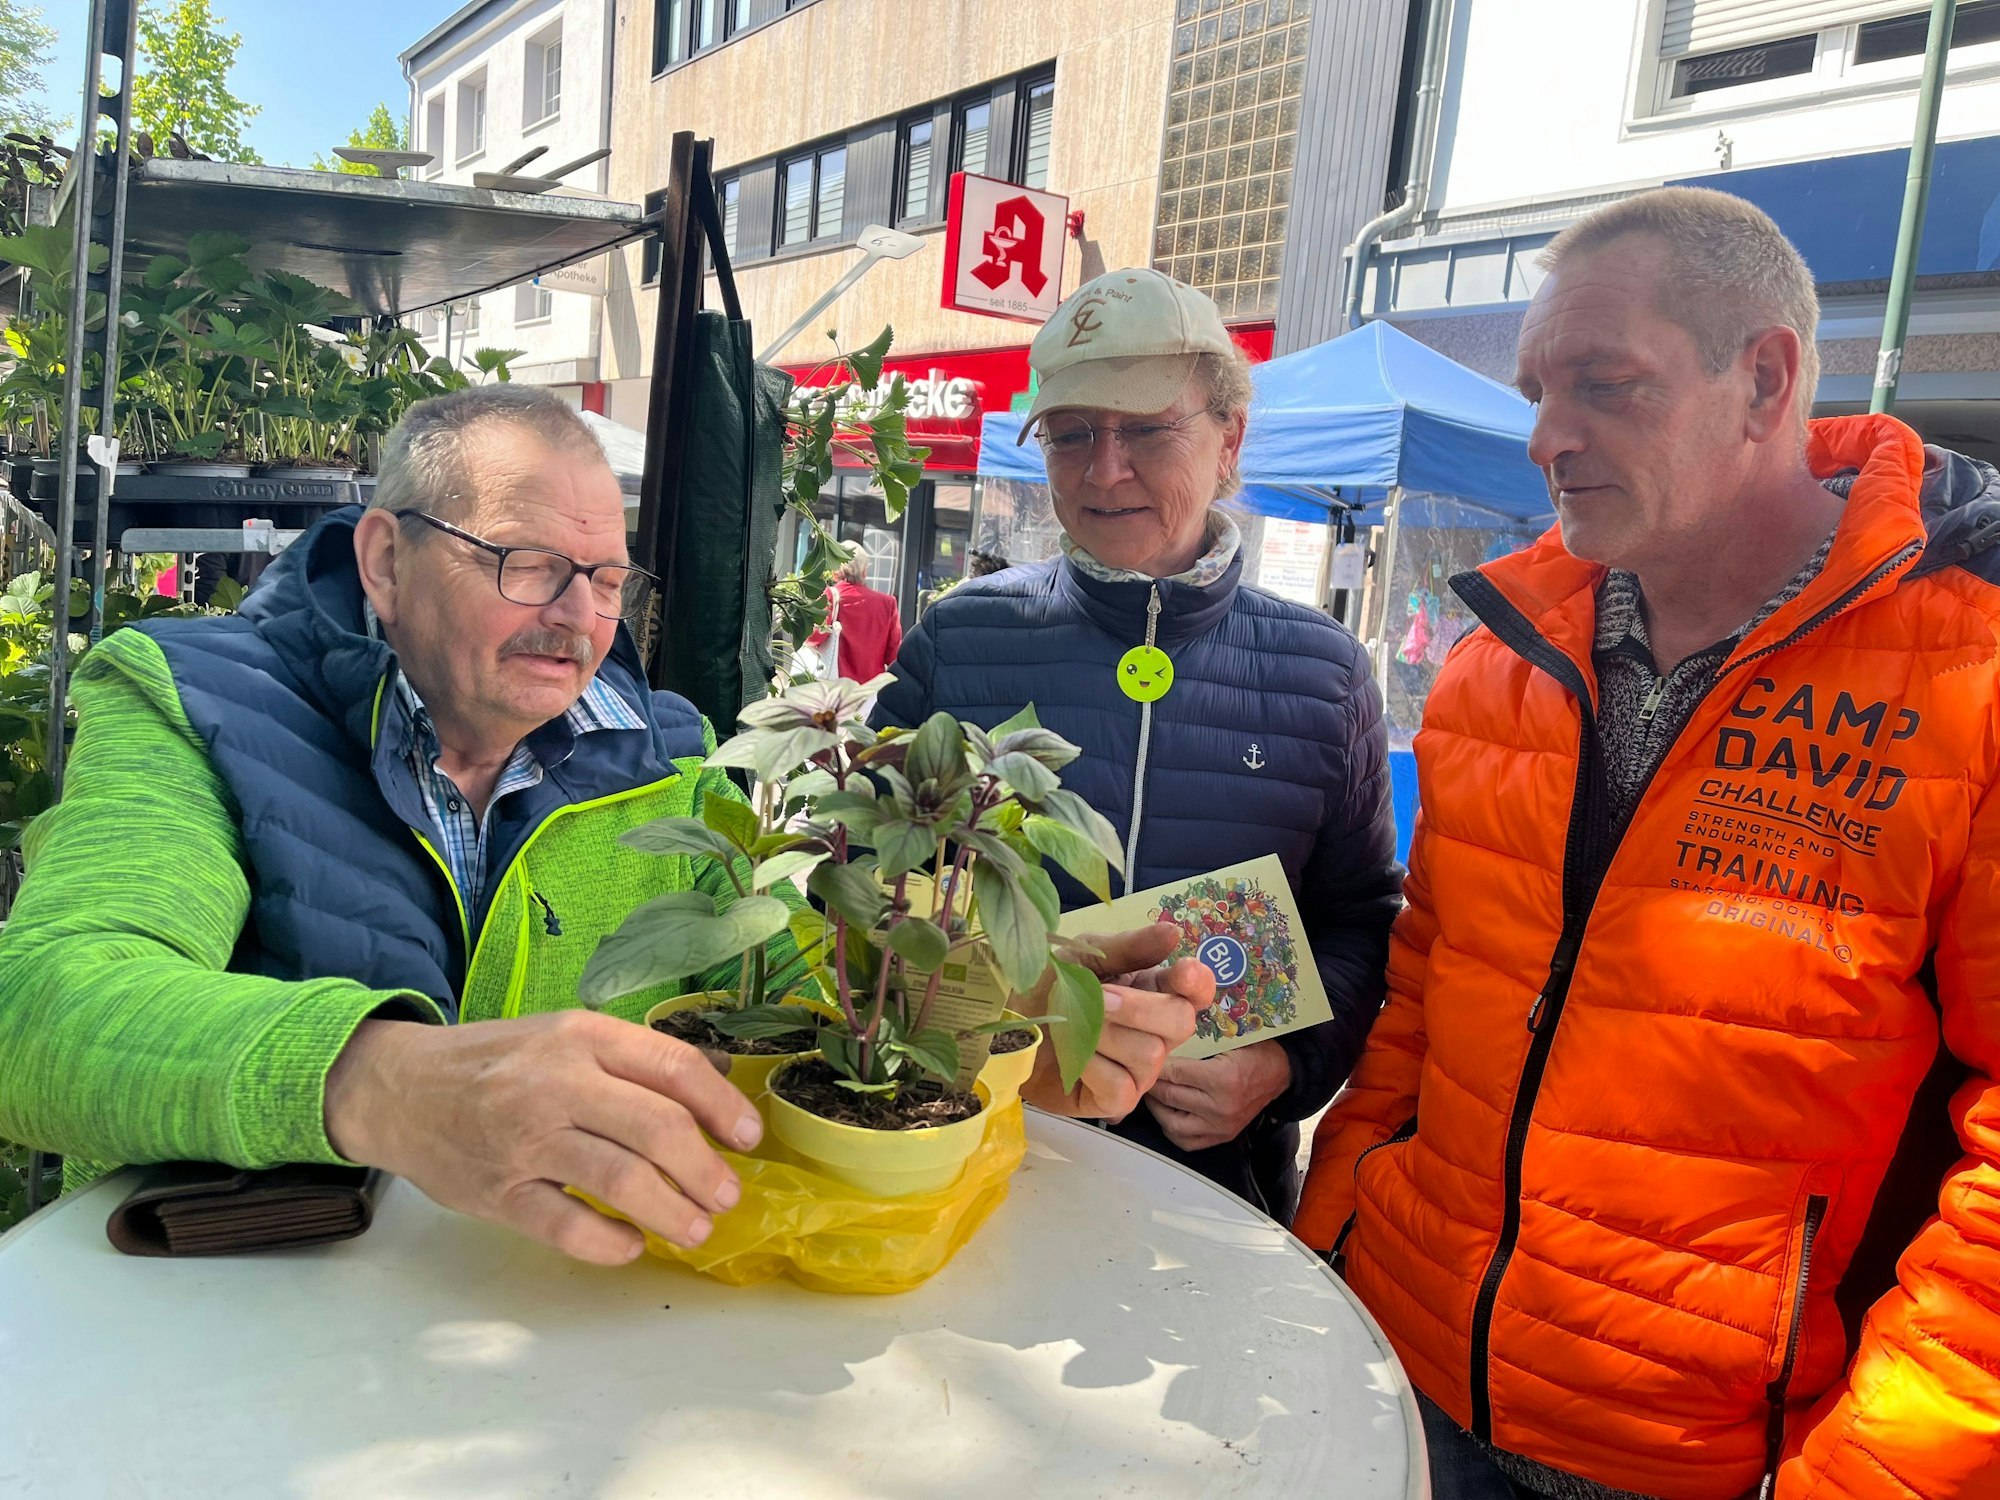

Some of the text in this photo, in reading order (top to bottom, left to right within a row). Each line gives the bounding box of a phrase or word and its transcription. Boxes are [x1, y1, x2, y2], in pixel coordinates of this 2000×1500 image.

[990, 298, 1028, 312] seit 1885
[1105, 288, 1133, 303] Paint
[1731, 677, 1921, 748] CAMP
[1714, 726, 1908, 811] DAVID
[1688, 810, 1835, 858] STRENGTH AND
[1699, 779, 1882, 848] CHALLENGE
[1684, 824, 1800, 861] ENDURANCE
[1676, 840, 1865, 917] TRAINING
[1706, 900, 1828, 952] ORIGINAL
[1206, 941, 1235, 981] Blu
